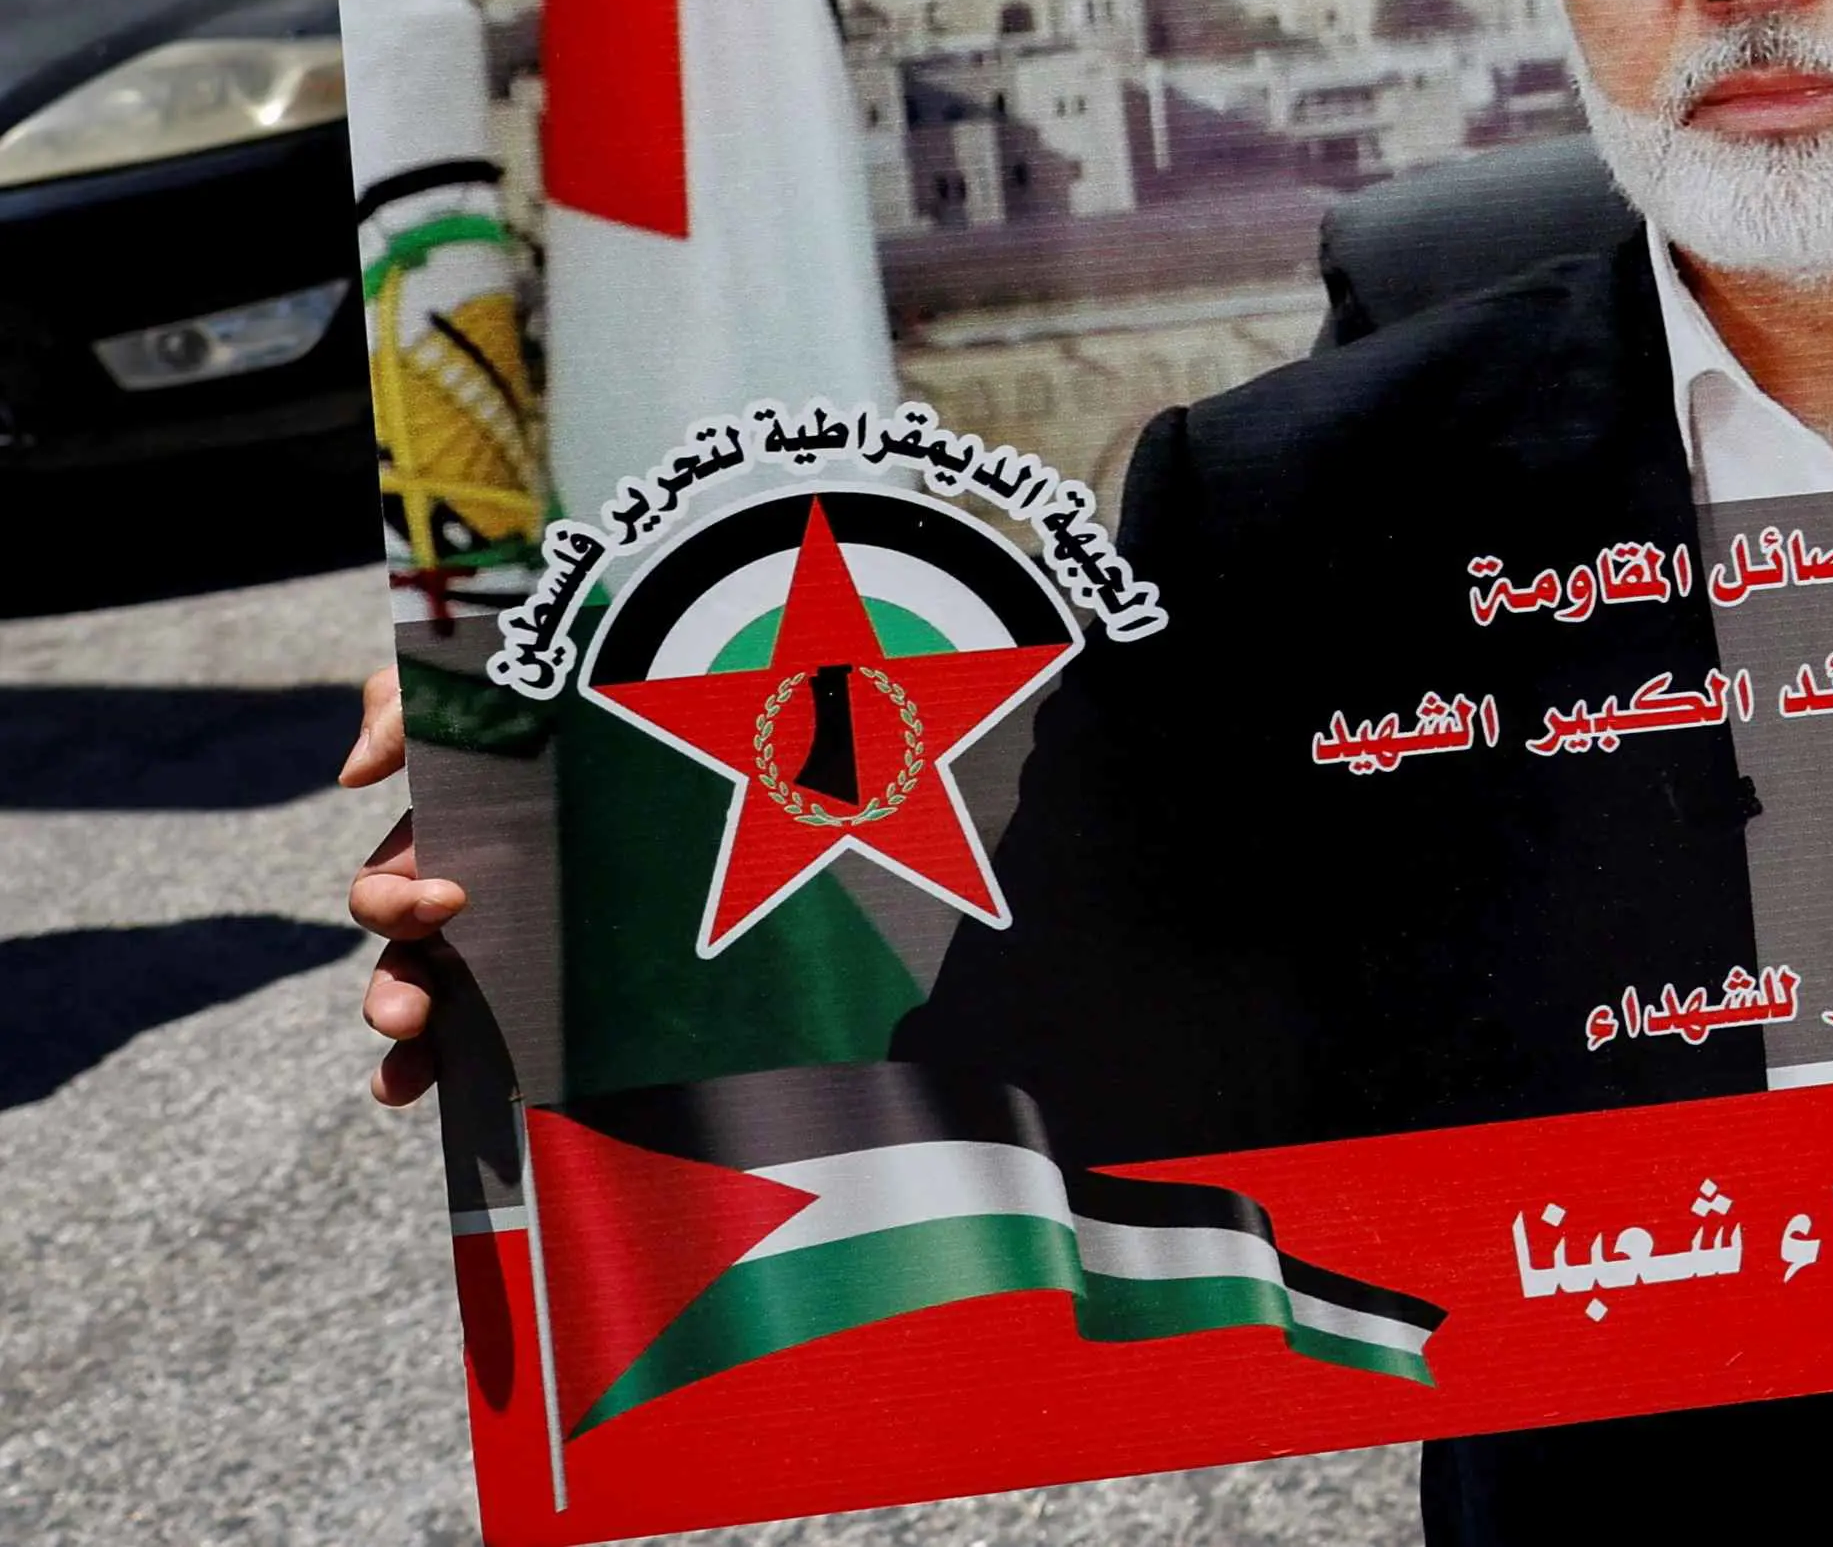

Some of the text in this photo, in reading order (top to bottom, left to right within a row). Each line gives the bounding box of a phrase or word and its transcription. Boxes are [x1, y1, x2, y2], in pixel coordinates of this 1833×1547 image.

[492, 407, 1163, 692] الجبهة الديمقراطية لتحرير فلسطين
[1468, 542, 1693, 626] المقاومة
[1312, 692, 1500, 775] الشهيد
[1526, 668, 1753, 756] الكبير
[1586, 965, 1801, 1051] للشهداء
[1511, 1178, 1743, 1322] شعبنا
